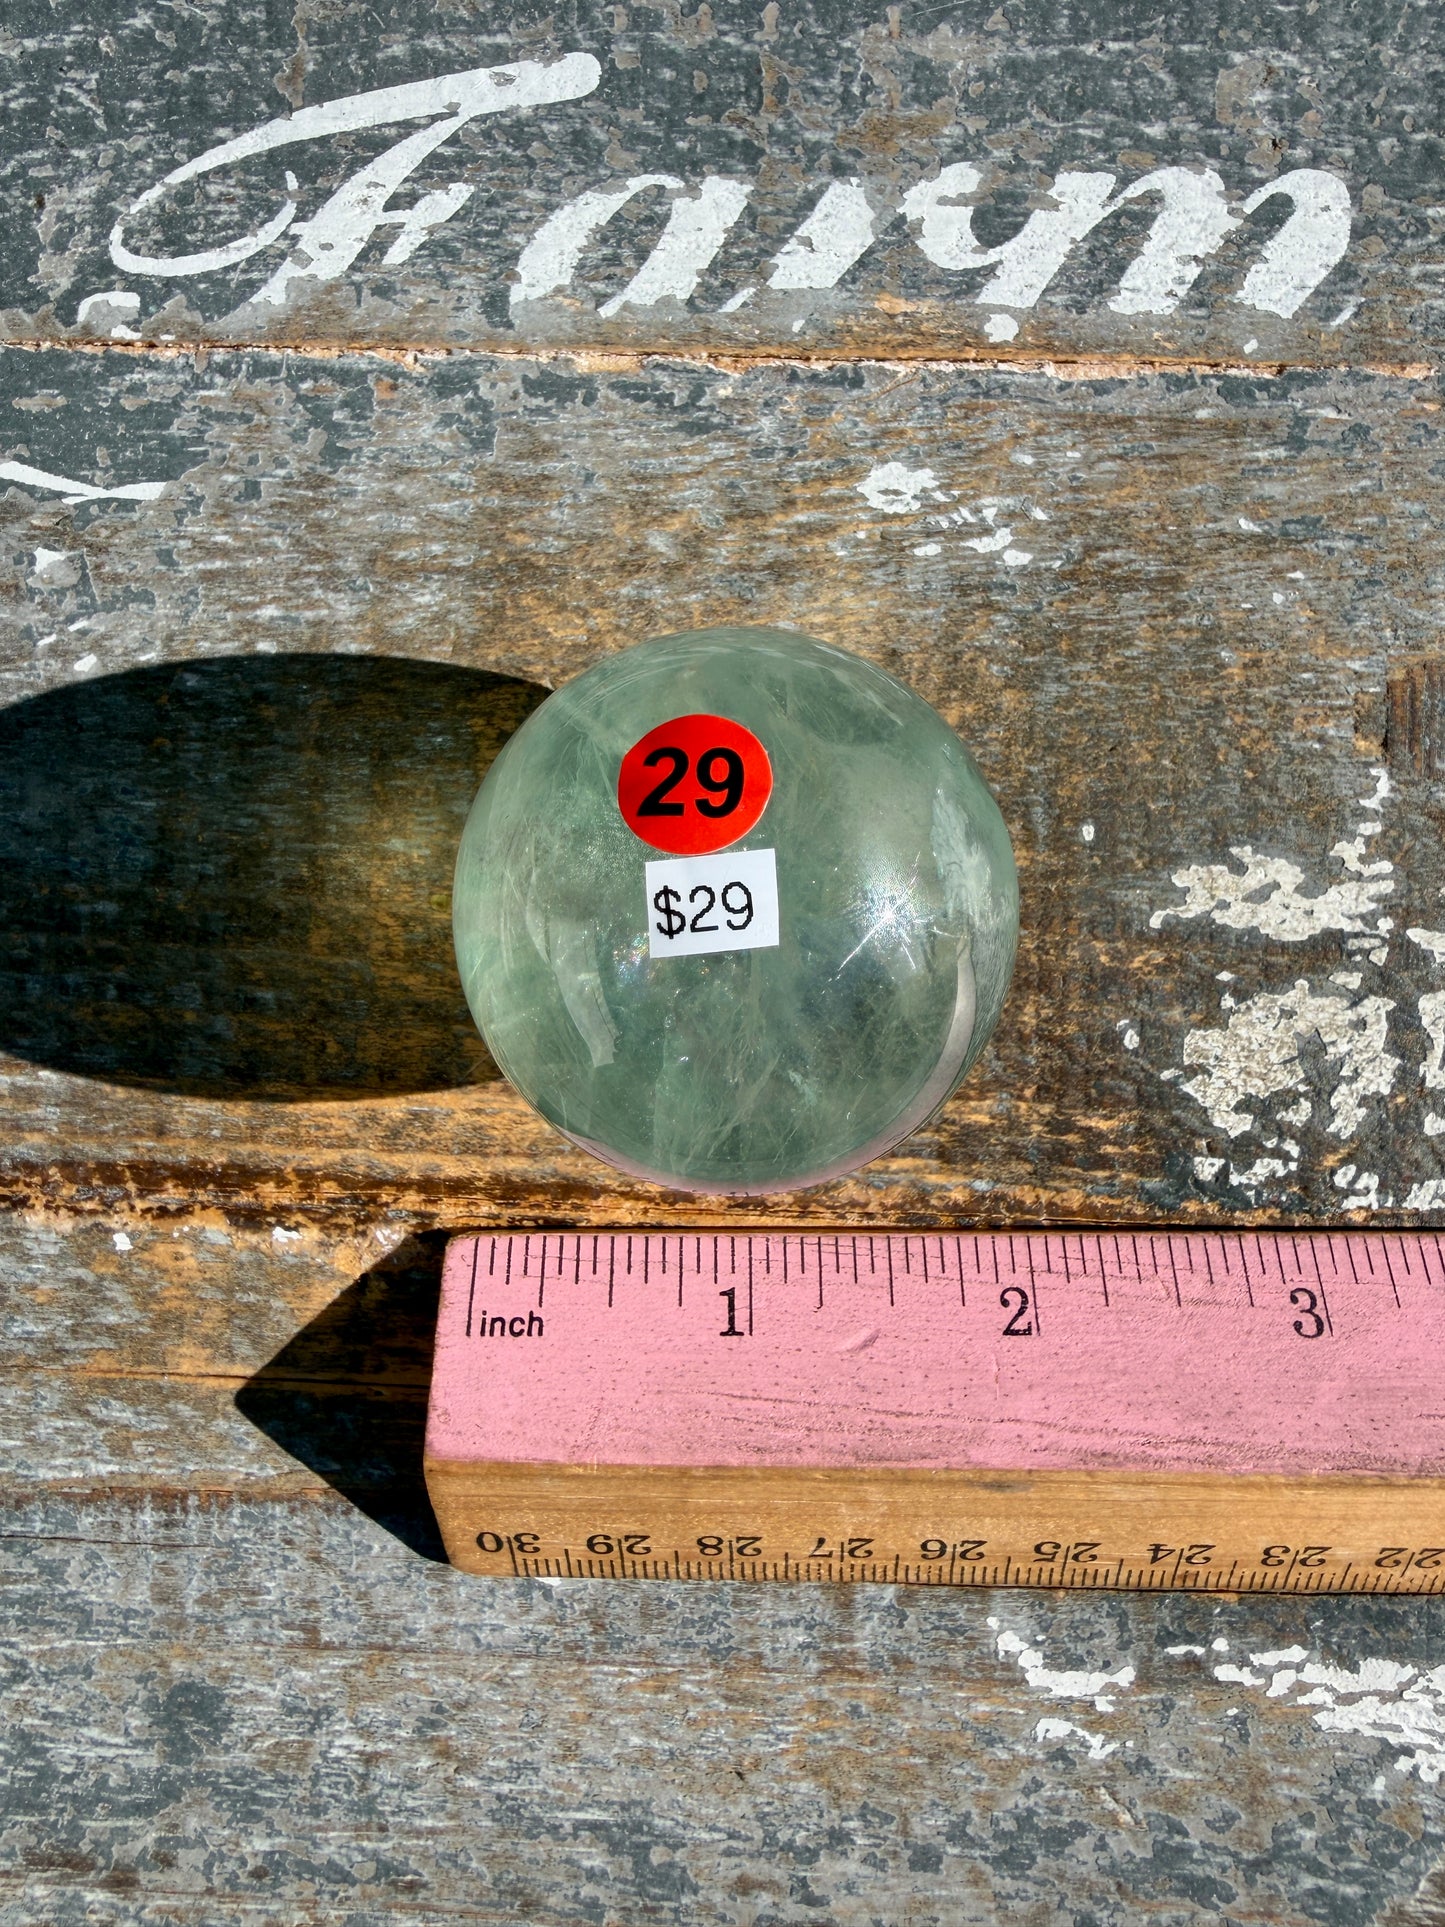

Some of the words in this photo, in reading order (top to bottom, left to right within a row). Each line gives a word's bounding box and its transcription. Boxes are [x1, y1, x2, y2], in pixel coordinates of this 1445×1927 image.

[76, 51, 1356, 342] Farm
[637, 746, 744, 818] 29
[653, 882, 754, 939] $29
[719, 1287, 744, 1337] 1
[1000, 1287, 1032, 1337] 2
[1289, 1288, 1325, 1338] 3
[480, 1311, 544, 1338] inch
[476, 1531, 541, 1554] 30
[586, 1535, 652, 1556] 29
[696, 1535, 763, 1557] 28
[809, 1537, 875, 1559] 27
[920, 1538, 988, 1561] 26
[1033, 1541, 1102, 1563] 25
[1148, 1543, 1216, 1565] 24
[1262, 1545, 1332, 1567] 23
